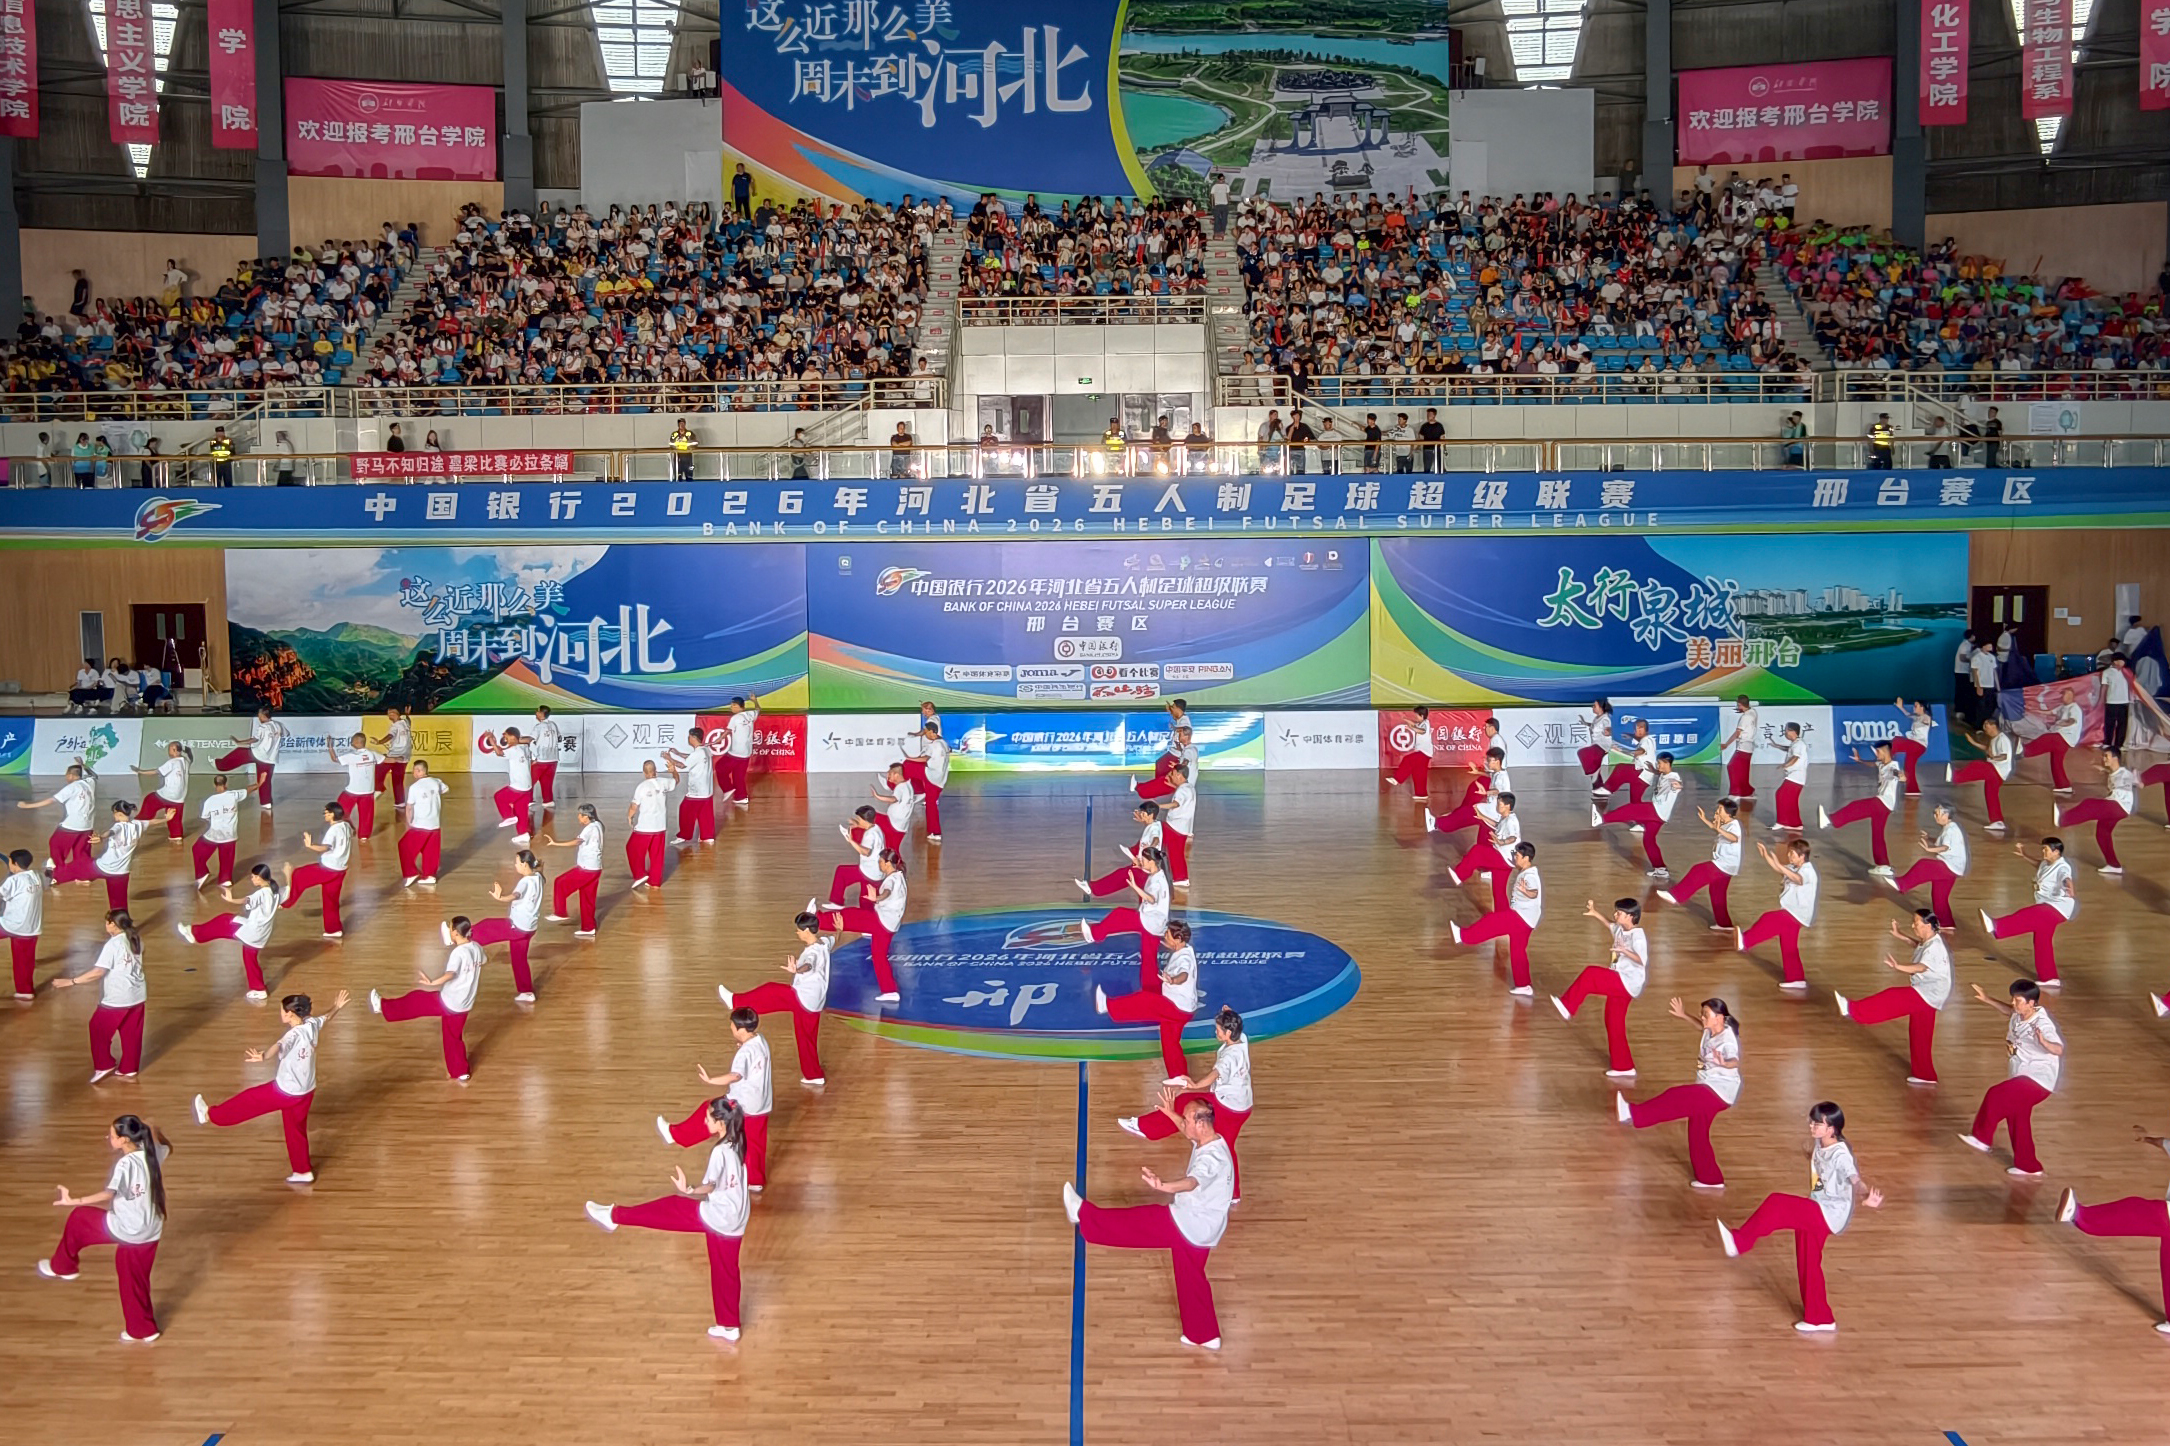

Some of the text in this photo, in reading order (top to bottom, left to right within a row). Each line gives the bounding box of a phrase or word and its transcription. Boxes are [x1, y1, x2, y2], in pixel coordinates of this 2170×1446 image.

[747, 0, 952, 53] 这么近那么美
[1930, 4, 1959, 106] 化工学院
[789, 25, 1092, 127] 周末到河北
[1689, 100, 1879, 130] 欢迎报考邢台学院
[298, 119, 485, 147] 欢迎报考邢台学院
[364, 479, 1635, 521] 中国银行2026年河北省五人制足球超级联赛
[1812, 477, 2036, 507] 邢台赛区
[702, 513, 1658, 536] BANK OF CHINA 2026 HEBEI FUTSAL SUPER LEAGUE
[400, 575, 566, 625] 这么近那么美
[943, 598, 1236, 612] BANK OF CHINA 2026 HEBEI FUTSAL SUPER LEAGUE
[1537, 566, 1746, 651] 太行泉城
[1027, 615, 1148, 631] 邢台赛区
[434, 603, 676, 684] 周末到河北
[1686, 635, 1802, 669] 美丽邢台
[752, 729, 797, 748] 国银行
[1430, 725, 1482, 742] 国银行
